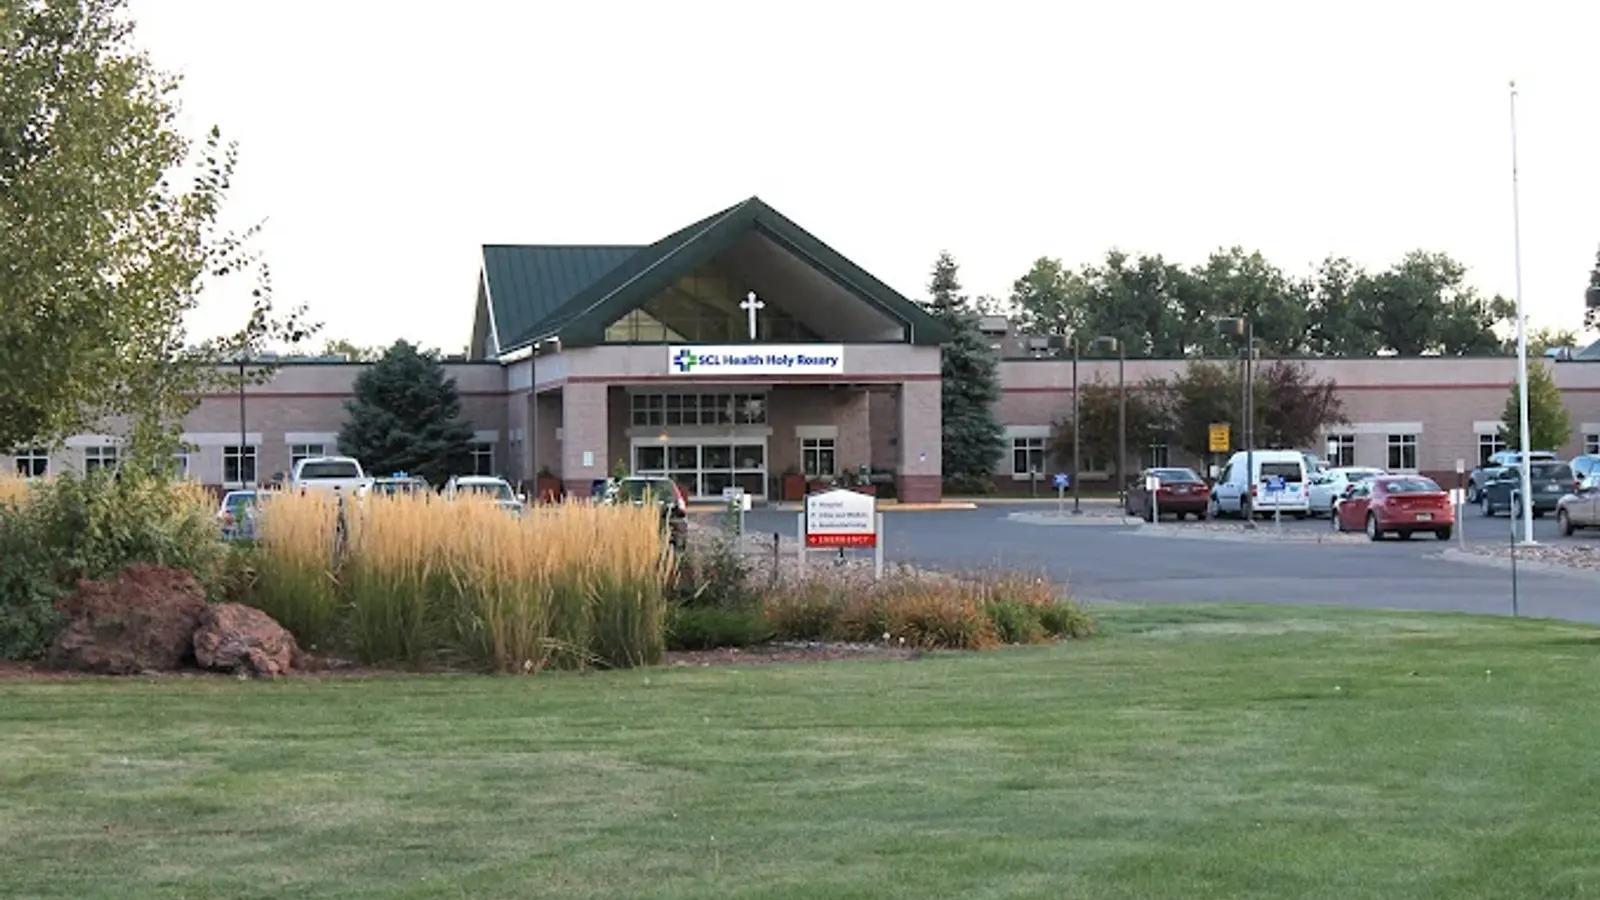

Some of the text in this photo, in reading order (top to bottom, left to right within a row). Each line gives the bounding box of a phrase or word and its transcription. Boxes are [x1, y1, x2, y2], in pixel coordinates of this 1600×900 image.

[698, 354, 839, 367] SCL Health Holy Rosary
